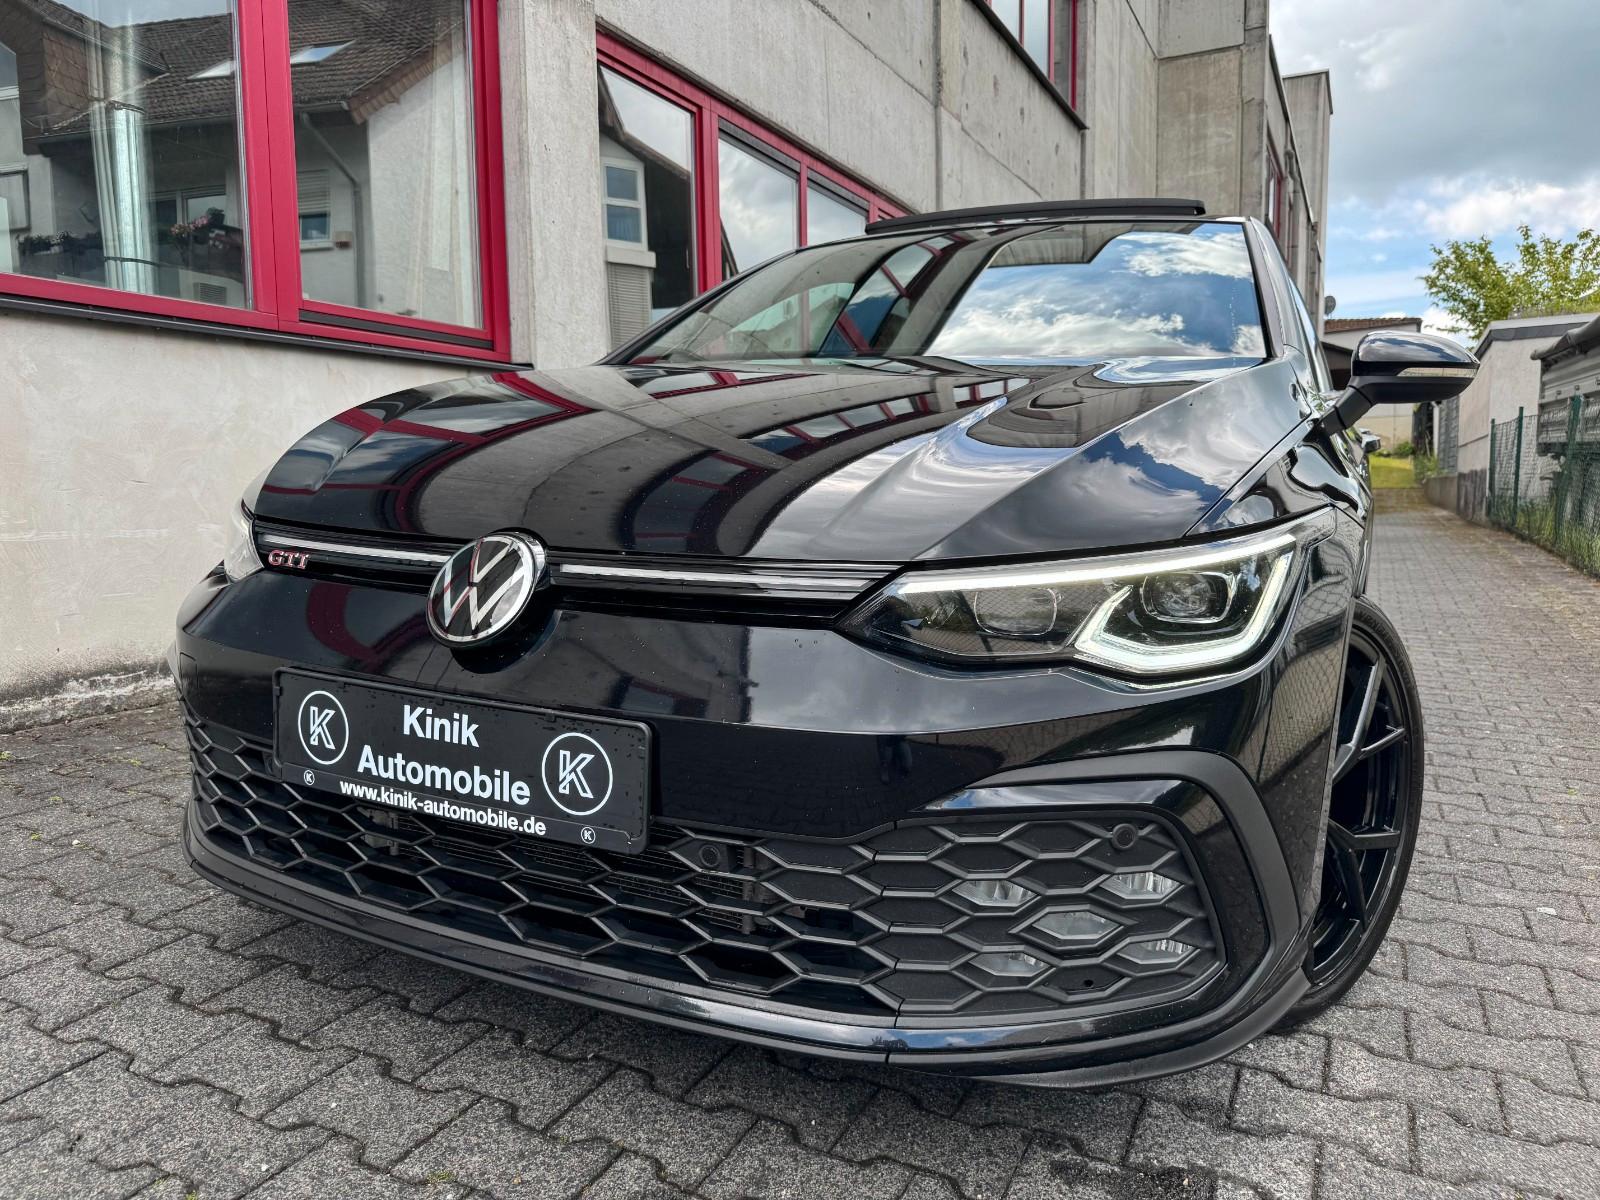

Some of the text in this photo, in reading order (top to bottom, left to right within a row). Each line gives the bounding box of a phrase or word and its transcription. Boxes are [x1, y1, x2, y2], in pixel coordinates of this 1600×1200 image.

[268, 549, 310, 570] GTI
[403, 704, 480, 748] Kinik
[357, 744, 531, 806] Automobile
[340, 781, 547, 836] www.kinik-automobile.de
